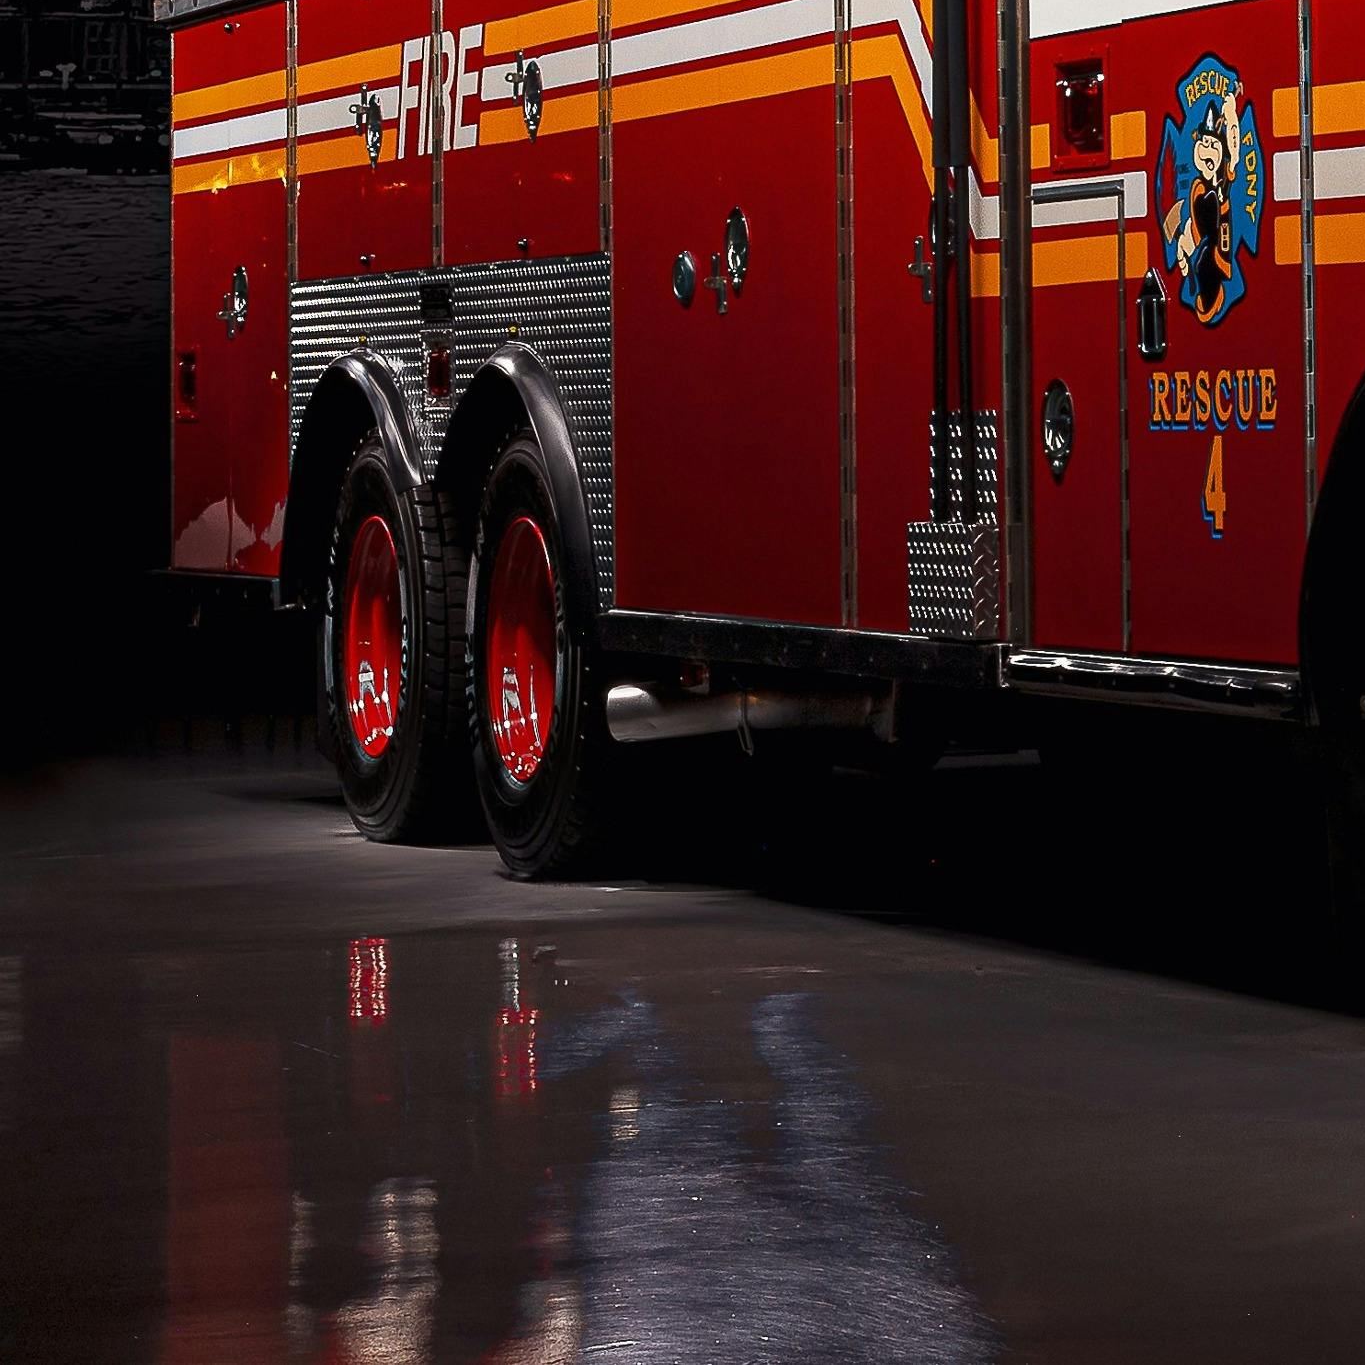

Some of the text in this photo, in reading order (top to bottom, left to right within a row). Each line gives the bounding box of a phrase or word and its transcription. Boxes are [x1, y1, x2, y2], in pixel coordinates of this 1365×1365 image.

[398, 24, 484, 160] FIRE
[1185, 71, 1230, 108] RESCUE
[1241, 130, 1258, 224] FDNY
[1150, 368, 1277, 430] RESCUE
[1203, 435, 1227, 538] 4
